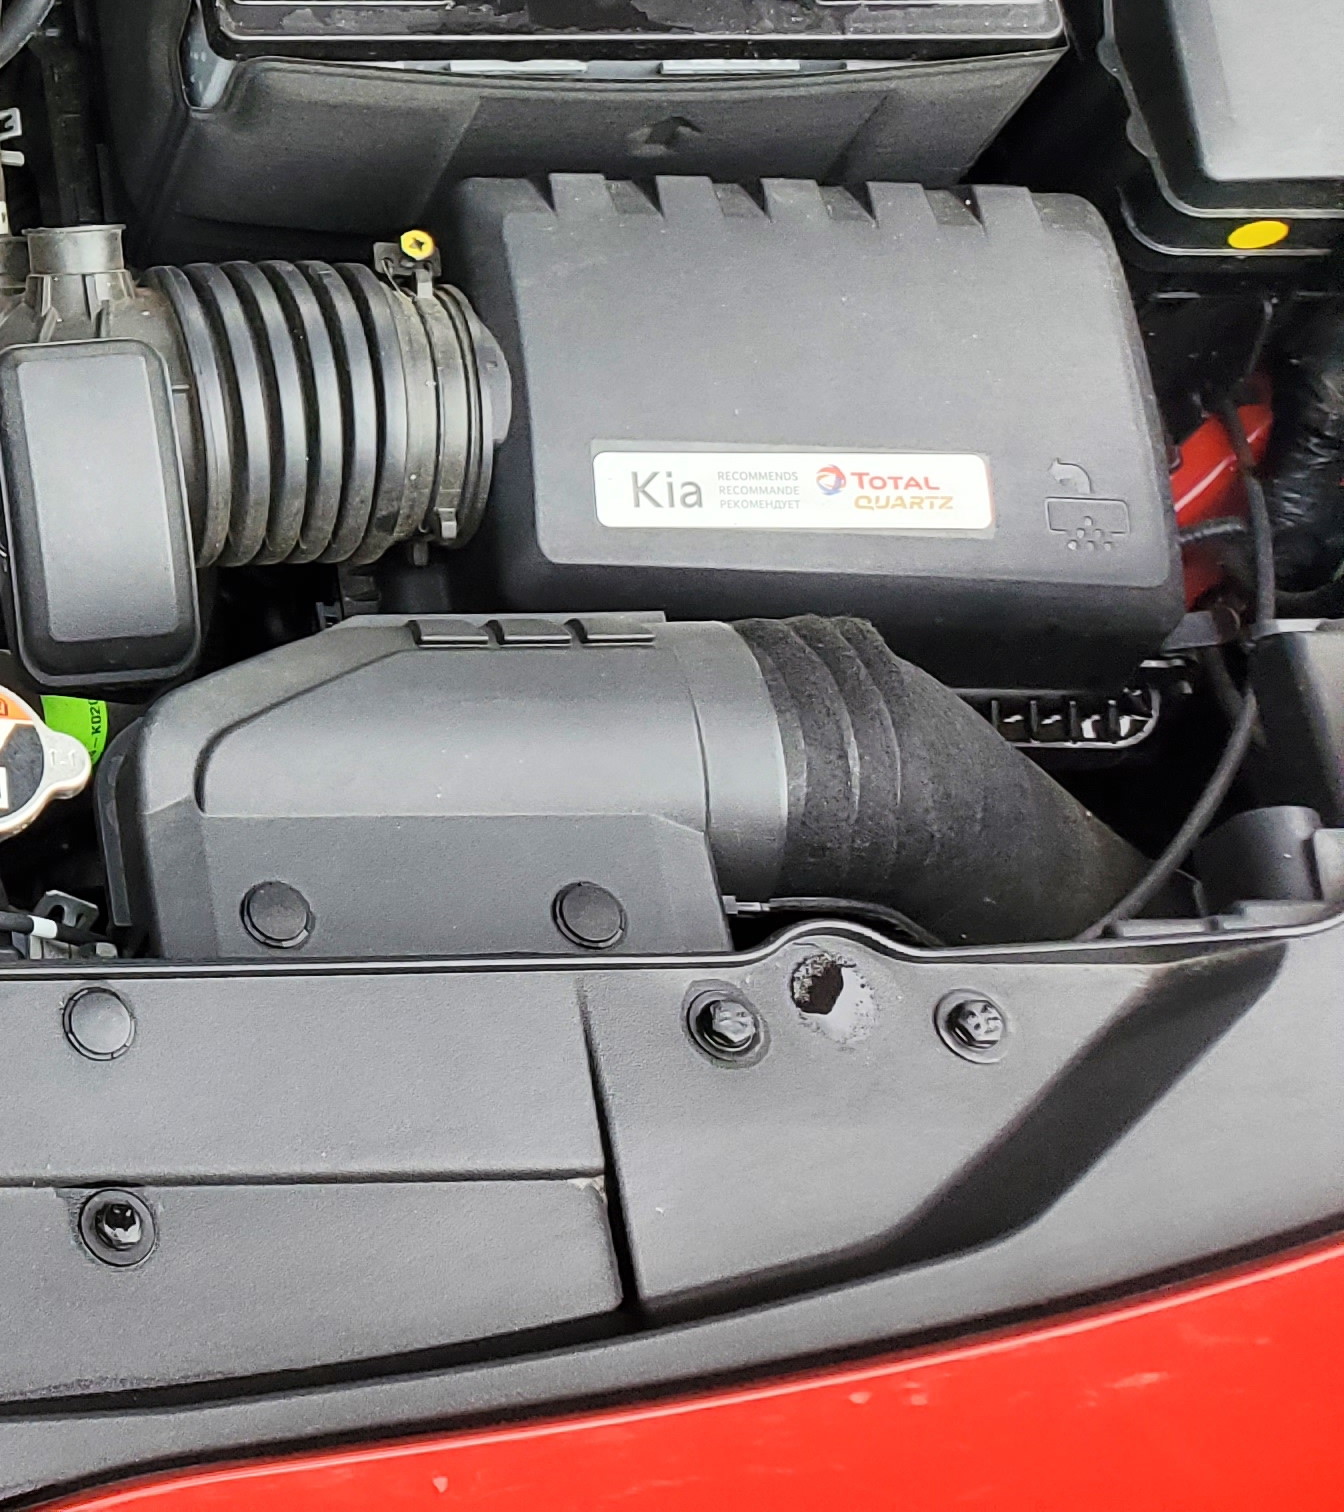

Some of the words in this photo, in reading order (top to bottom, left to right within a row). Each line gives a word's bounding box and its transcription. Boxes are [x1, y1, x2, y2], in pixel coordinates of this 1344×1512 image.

[716, 470, 799, 483] RECOMMENDS
[850, 471, 940, 491] TOTAL
[630, 469, 704, 509] Kia
[718, 484, 800, 496] RECOMMANDE
[719, 498, 801, 511] РЕКОМЕНДУЕТ
[853, 494, 954, 511] QUARTZ
